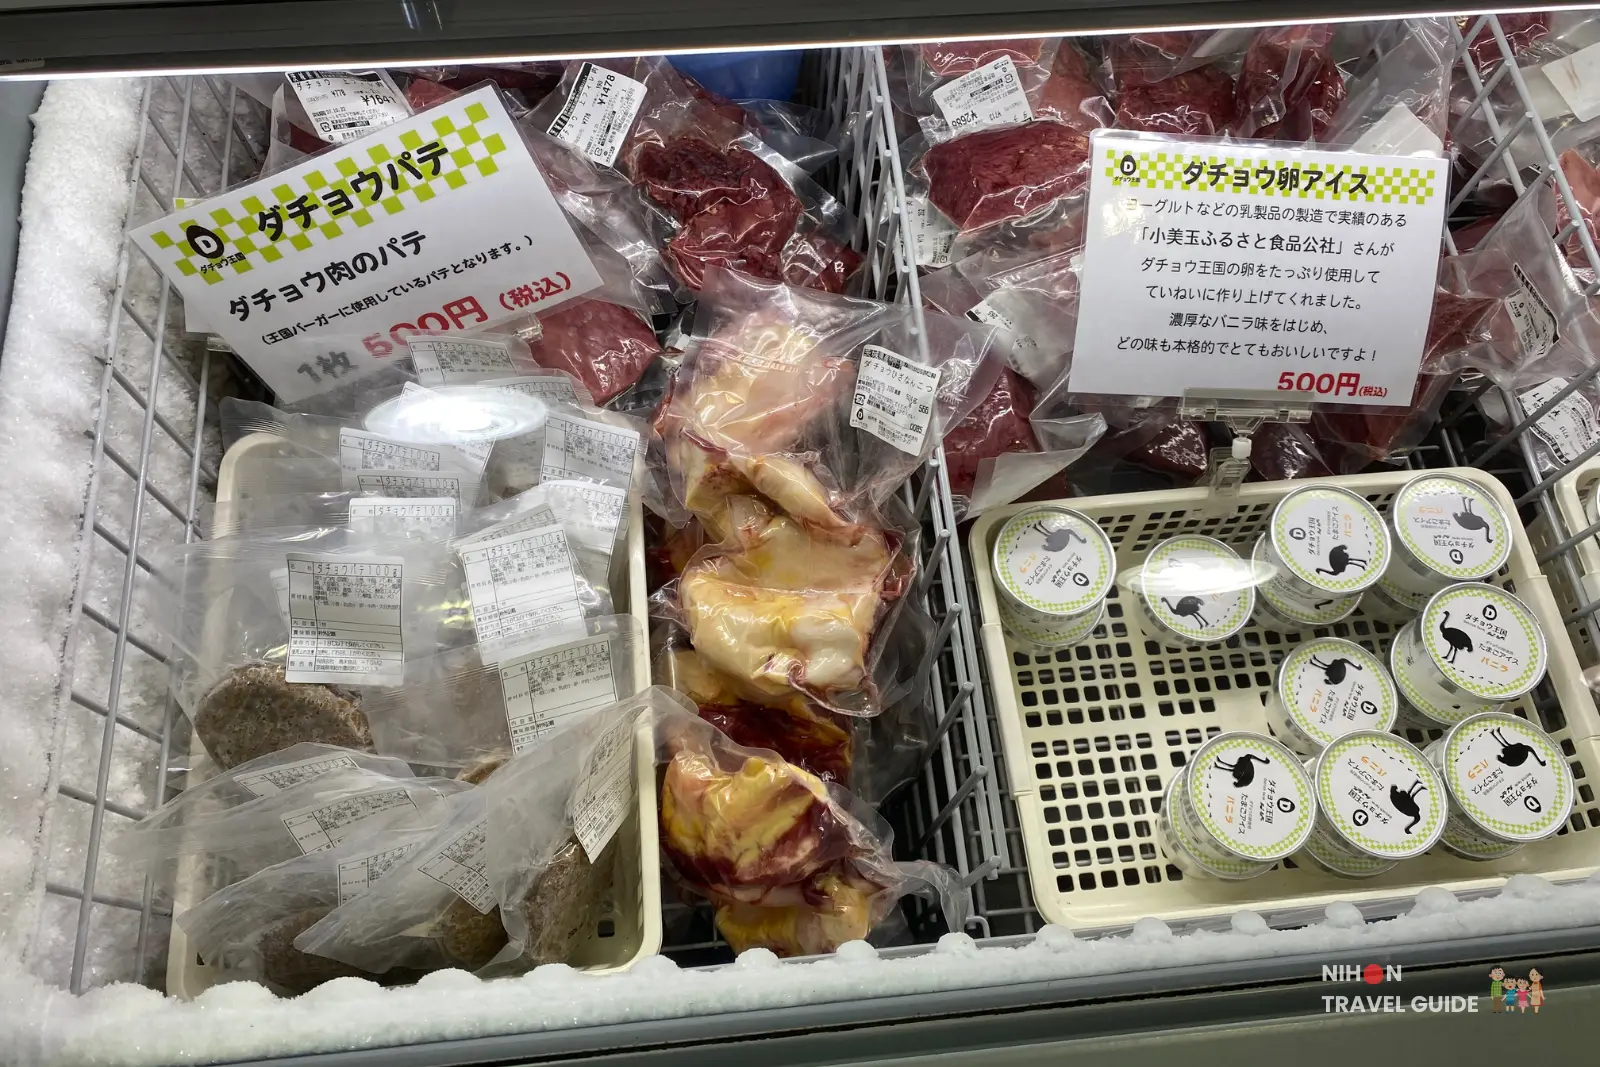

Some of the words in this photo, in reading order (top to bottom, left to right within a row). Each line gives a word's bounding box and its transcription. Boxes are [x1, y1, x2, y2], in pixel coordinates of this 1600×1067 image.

[594, 73, 617, 106] ¥1478
[258, 141, 449, 242] ダチョウパテ
[1183, 162, 1369, 194] ダチョウ卵アイス
[1126, 198, 1407, 227] ヨーグルトなどの乳製品の製造で実績のある
[200, 251, 246, 273] ダチョウ王国
[1141, 258, 1380, 283] ダチョウ王国の卵をたっぷり使用して
[229, 231, 426, 322] ダチョウ肉のパテ
[261, 236, 533, 345] （王国バーガーに使用しているパテとなります。）
[1145, 285, 1364, 310] ていねいに作り上げてくれました。
[298, 351, 358, 382] 1枚
[362, 296, 488, 360] 500円
[500, 272, 572, 312] （税込）
[1170, 313, 1329, 335] 濃厚なバニラ味をはじめ、
[1117, 337, 1377, 362] どの味も本格的でとてもおいしいですよ！
[864, 360, 932, 392] ダチョウひざなんこつ
[918, 405, 929, 414] 566
[1412, 516, 1450, 525] たまごアイス
[491, 533, 562, 555] ダチョウパテ100g
[317, 563, 397, 577] ダチョウパテ100g
[1024, 554, 1051, 587] たまごアイス
[1463, 612, 1509, 636] ダチョウ王国
[530, 644, 607, 669] ダチョウパテ100g
[1477, 643, 1520, 665] たまごアイス
[1480, 656, 1509, 673] バニラ
[1309, 688, 1322, 713] バニラ
[1318, 689, 1336, 724] たまごアイス
[1346, 682, 1364, 721] ダチョウ王国
[1343, 757, 1386, 791] たまごアイス
[1358, 754, 1387, 777] バニラ
[1465, 756, 1490, 783] バニラ
[1470, 762, 1504, 799] たまごアイス
[1503, 772, 1538, 811] ダチョウ王国
[1224, 795, 1235, 823] バニラ
[1237, 793, 1249, 835] たまごアイス
[1263, 779, 1277, 823] ダチョウ王国
[1344, 789, 1391, 826] ダチョウ王国
